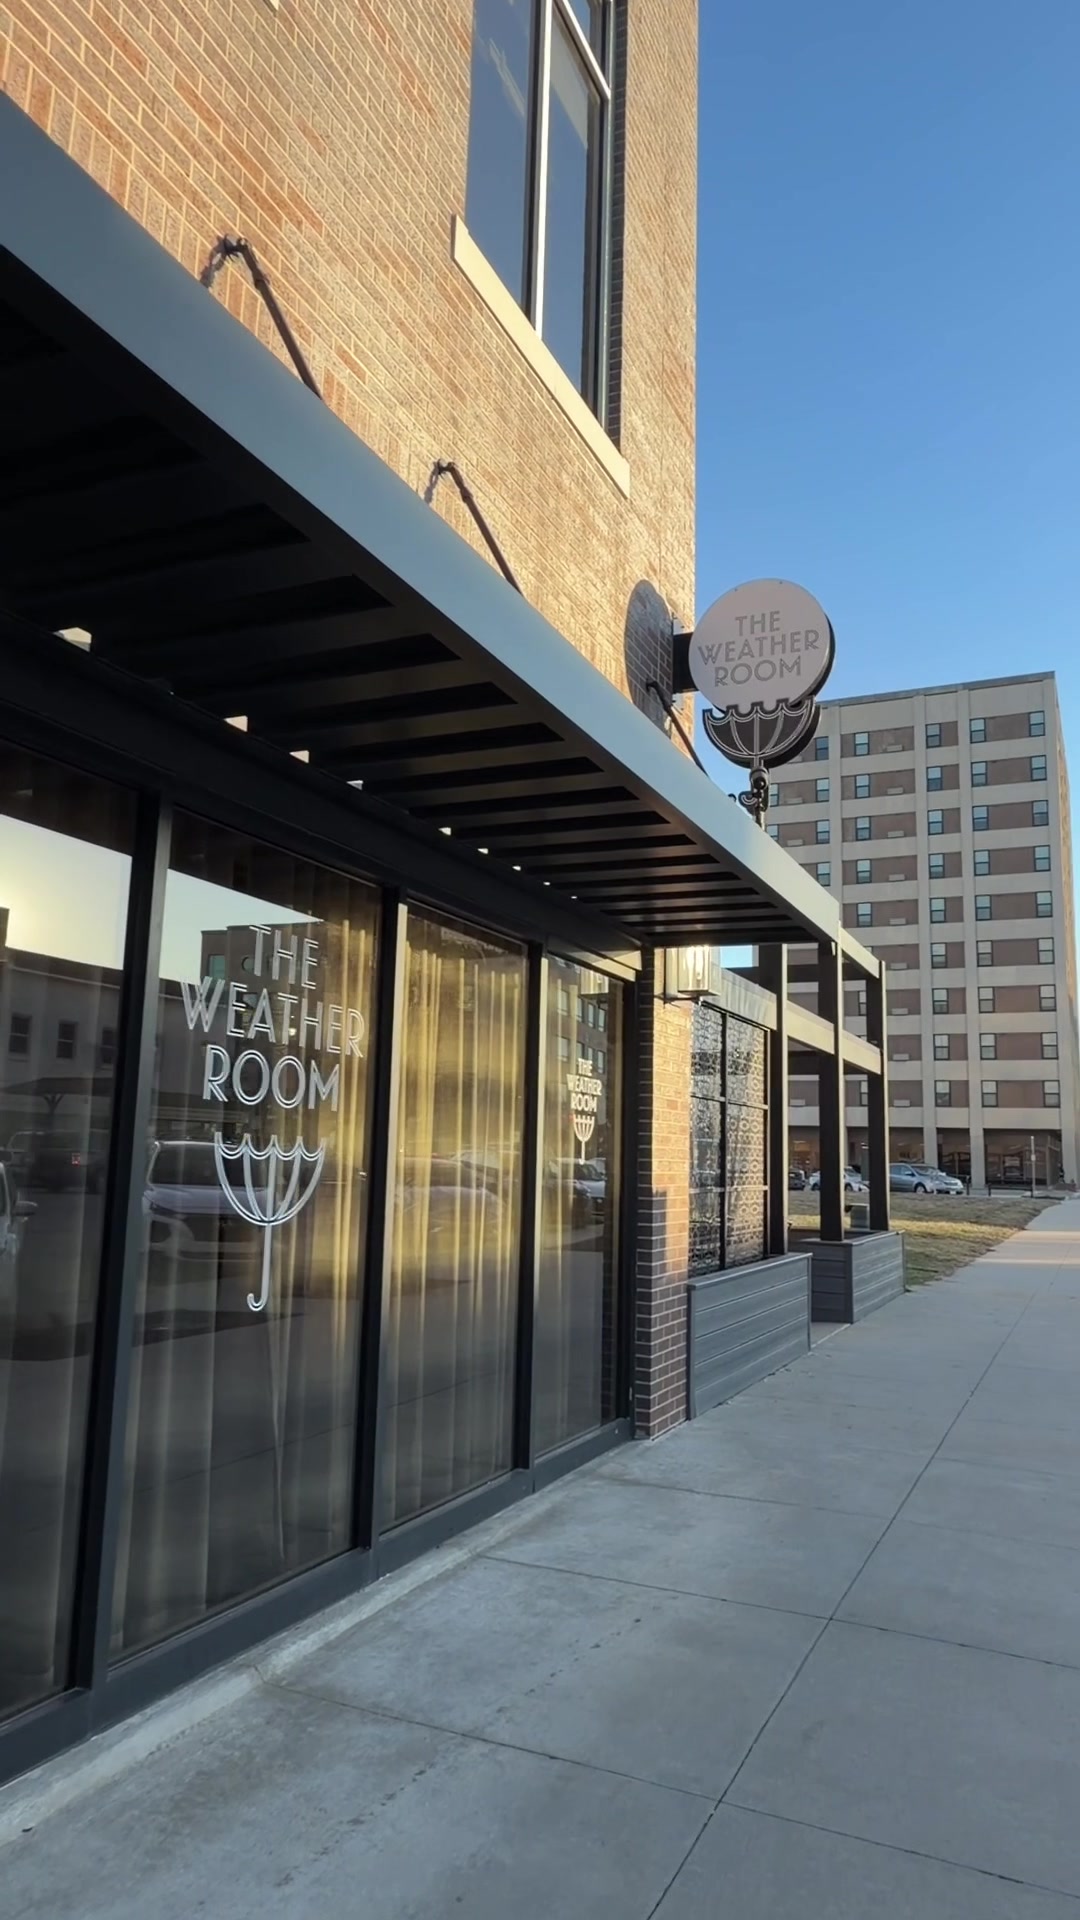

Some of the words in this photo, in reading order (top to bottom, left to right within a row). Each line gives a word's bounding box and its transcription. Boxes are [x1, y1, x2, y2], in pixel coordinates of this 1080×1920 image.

[735, 610, 781, 637] THE
[698, 629, 820, 666] WEATHER
[714, 655, 801, 687] ROOM
[249, 924, 319, 990] THE
[180, 975, 365, 1058] WEATHER
[202, 1044, 340, 1112] ROOM
[578, 1058, 592, 1076] THE
[566, 1073, 602, 1096] WEATHER
[571, 1092, 597, 1112] ROOM
